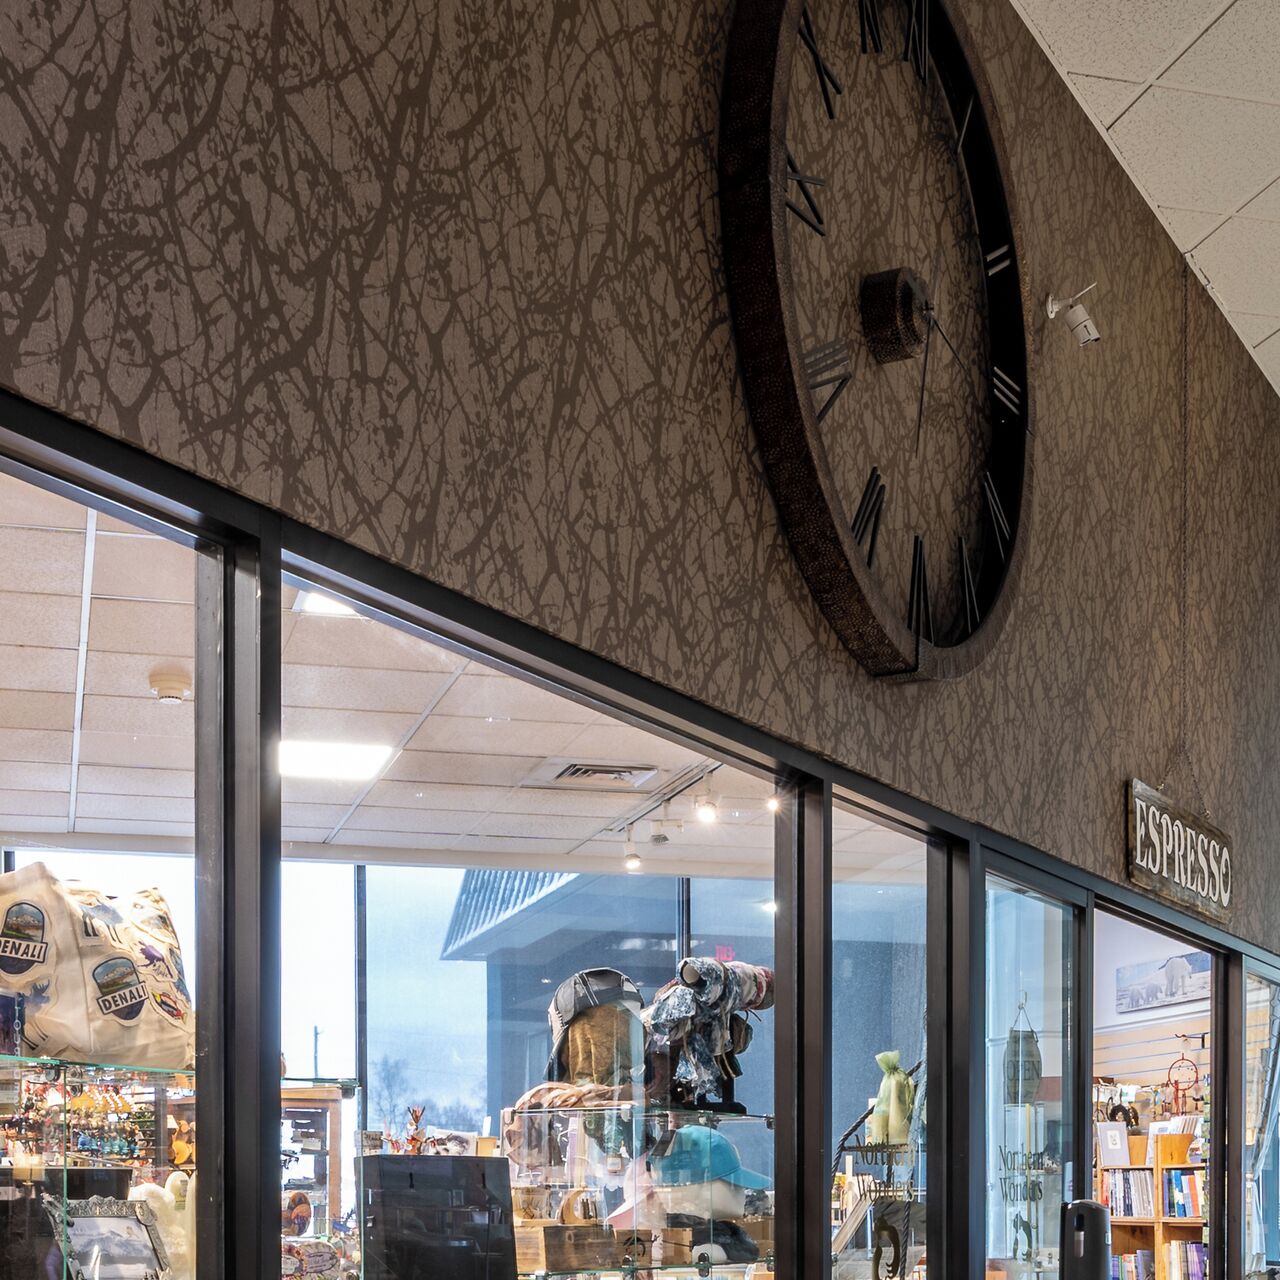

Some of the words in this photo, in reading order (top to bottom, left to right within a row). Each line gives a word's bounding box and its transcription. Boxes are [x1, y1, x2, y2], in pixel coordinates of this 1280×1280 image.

[1135, 798, 1231, 908] ESPRESSO
[102, 984, 148, 1011] DENALI
[855, 1134, 916, 1167] Northern
[998, 1142, 1044, 1172] Norhern
[857, 1172, 915, 1202] Wonders
